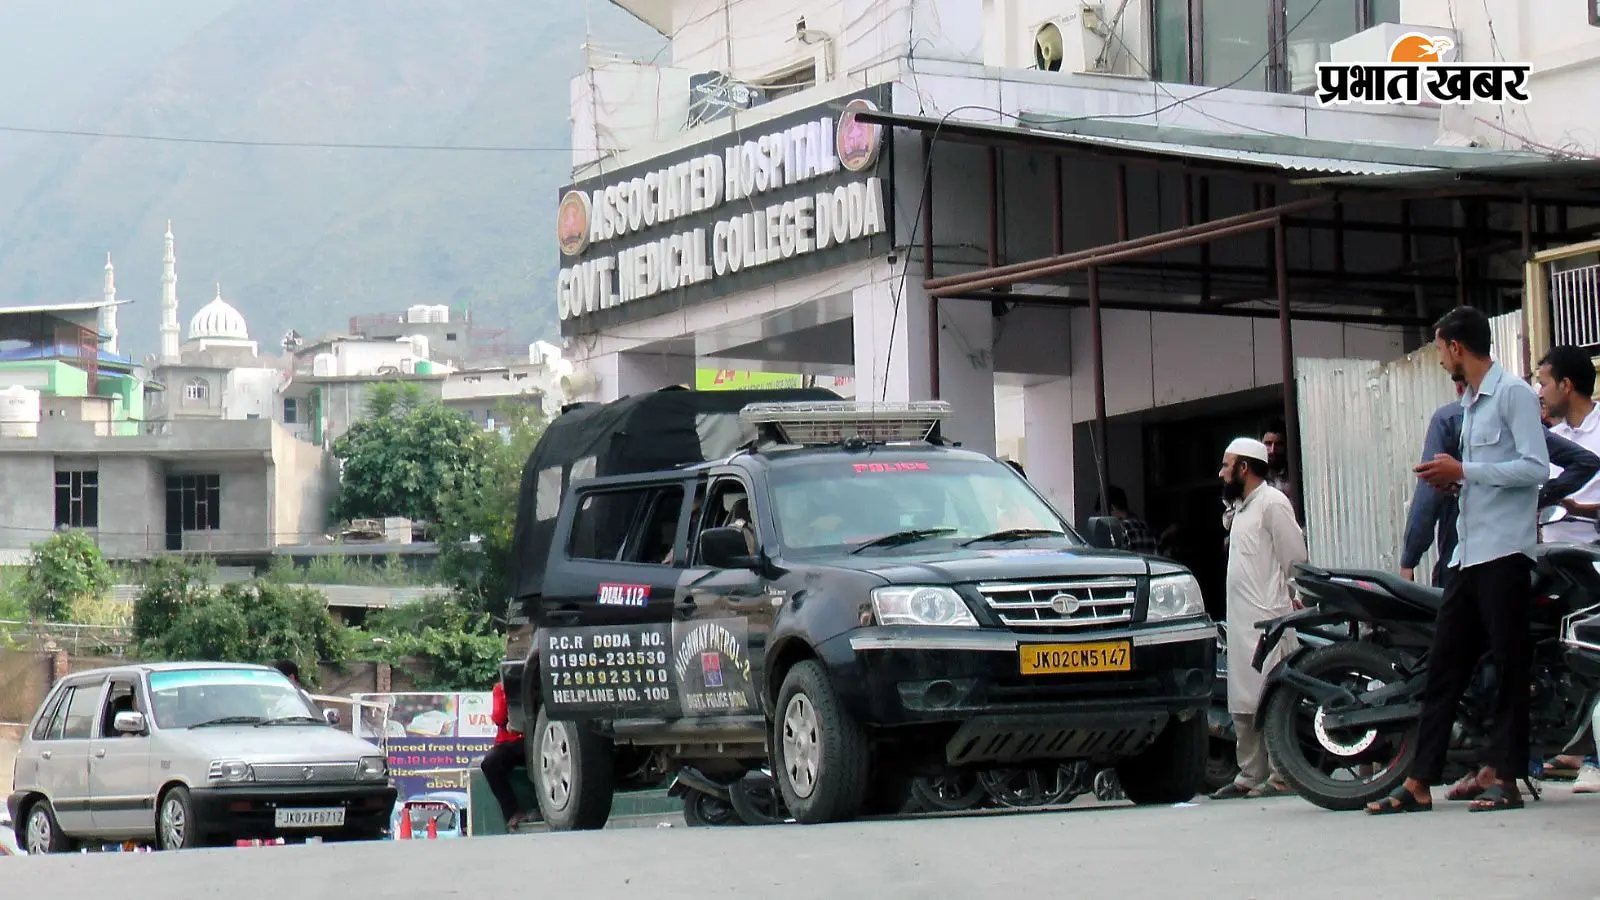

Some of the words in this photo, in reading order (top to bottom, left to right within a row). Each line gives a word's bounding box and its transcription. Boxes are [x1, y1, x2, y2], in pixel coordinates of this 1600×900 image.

[590, 154, 723, 243] ASSOCIATED
[725, 117, 840, 201] HOSPITAL
[558, 256, 620, 321] GOVT.
[619, 228, 713, 303] MEDICAL
[713, 197, 815, 276] COLLEGE
[816, 177, 887, 249] DODA
[852, 462, 930, 473] POLICE
[600, 586, 623, 605] DIAL
[626, 587, 645, 606] 112
[549, 636, 583, 649] P.C.R
[593, 633, 631, 648] DODA
[641, 632, 665, 646] NO.
[549, 651, 665, 668] 01996-233530
[675, 624, 708, 682] HIGHWAY
[1033, 648, 1126, 669] JK02CN5147
[552, 688, 615, 703] HELPLINE
[617, 688, 641, 701] NO.
[644, 687, 670, 701] 100
[428, 743, 453, 752] free
[422, 755, 453, 765] Lakh
[456, 755, 469, 764] to
